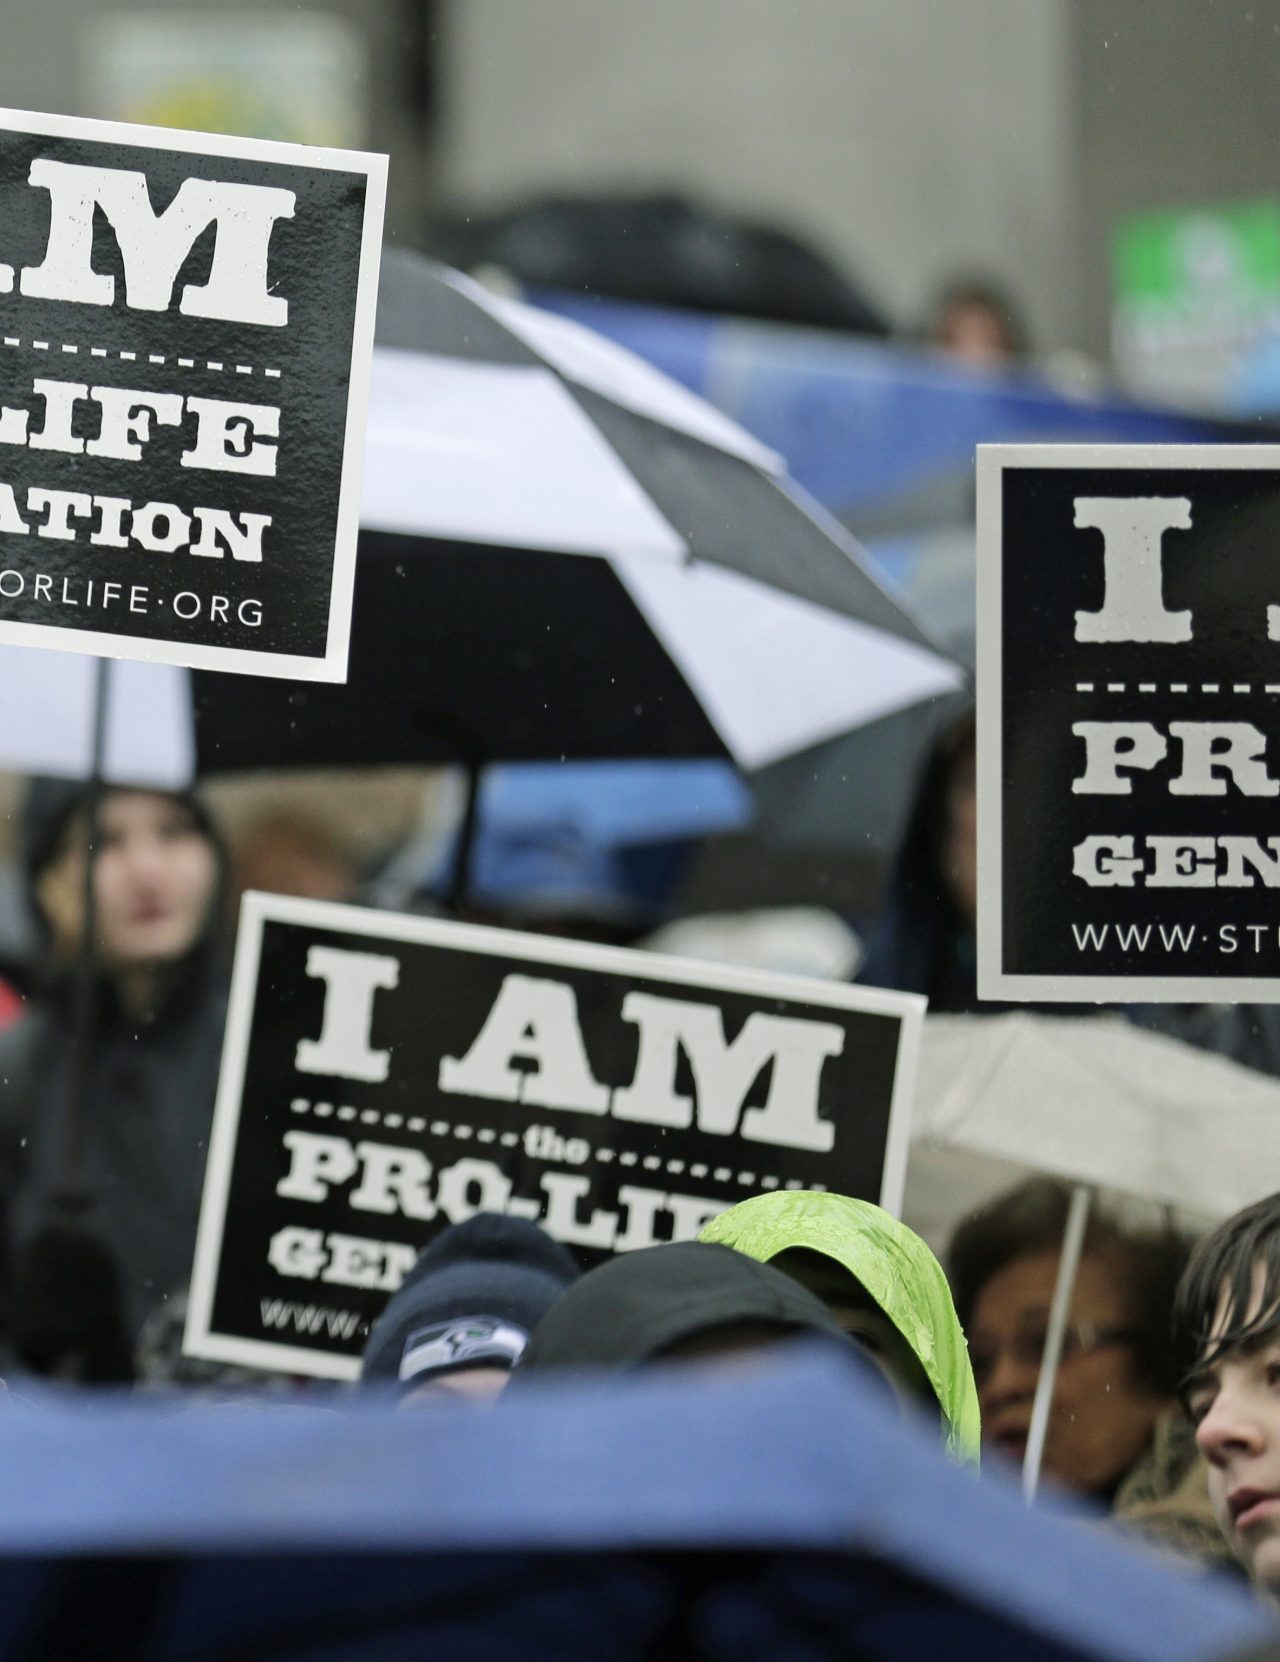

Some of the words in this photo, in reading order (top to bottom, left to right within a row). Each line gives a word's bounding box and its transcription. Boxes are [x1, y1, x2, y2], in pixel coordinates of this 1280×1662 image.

[1073, 496, 1194, 644] I
[295, 946, 400, 1082] I
[438, 974, 845, 1152] AM
[523, 1124, 590, 1165] the
